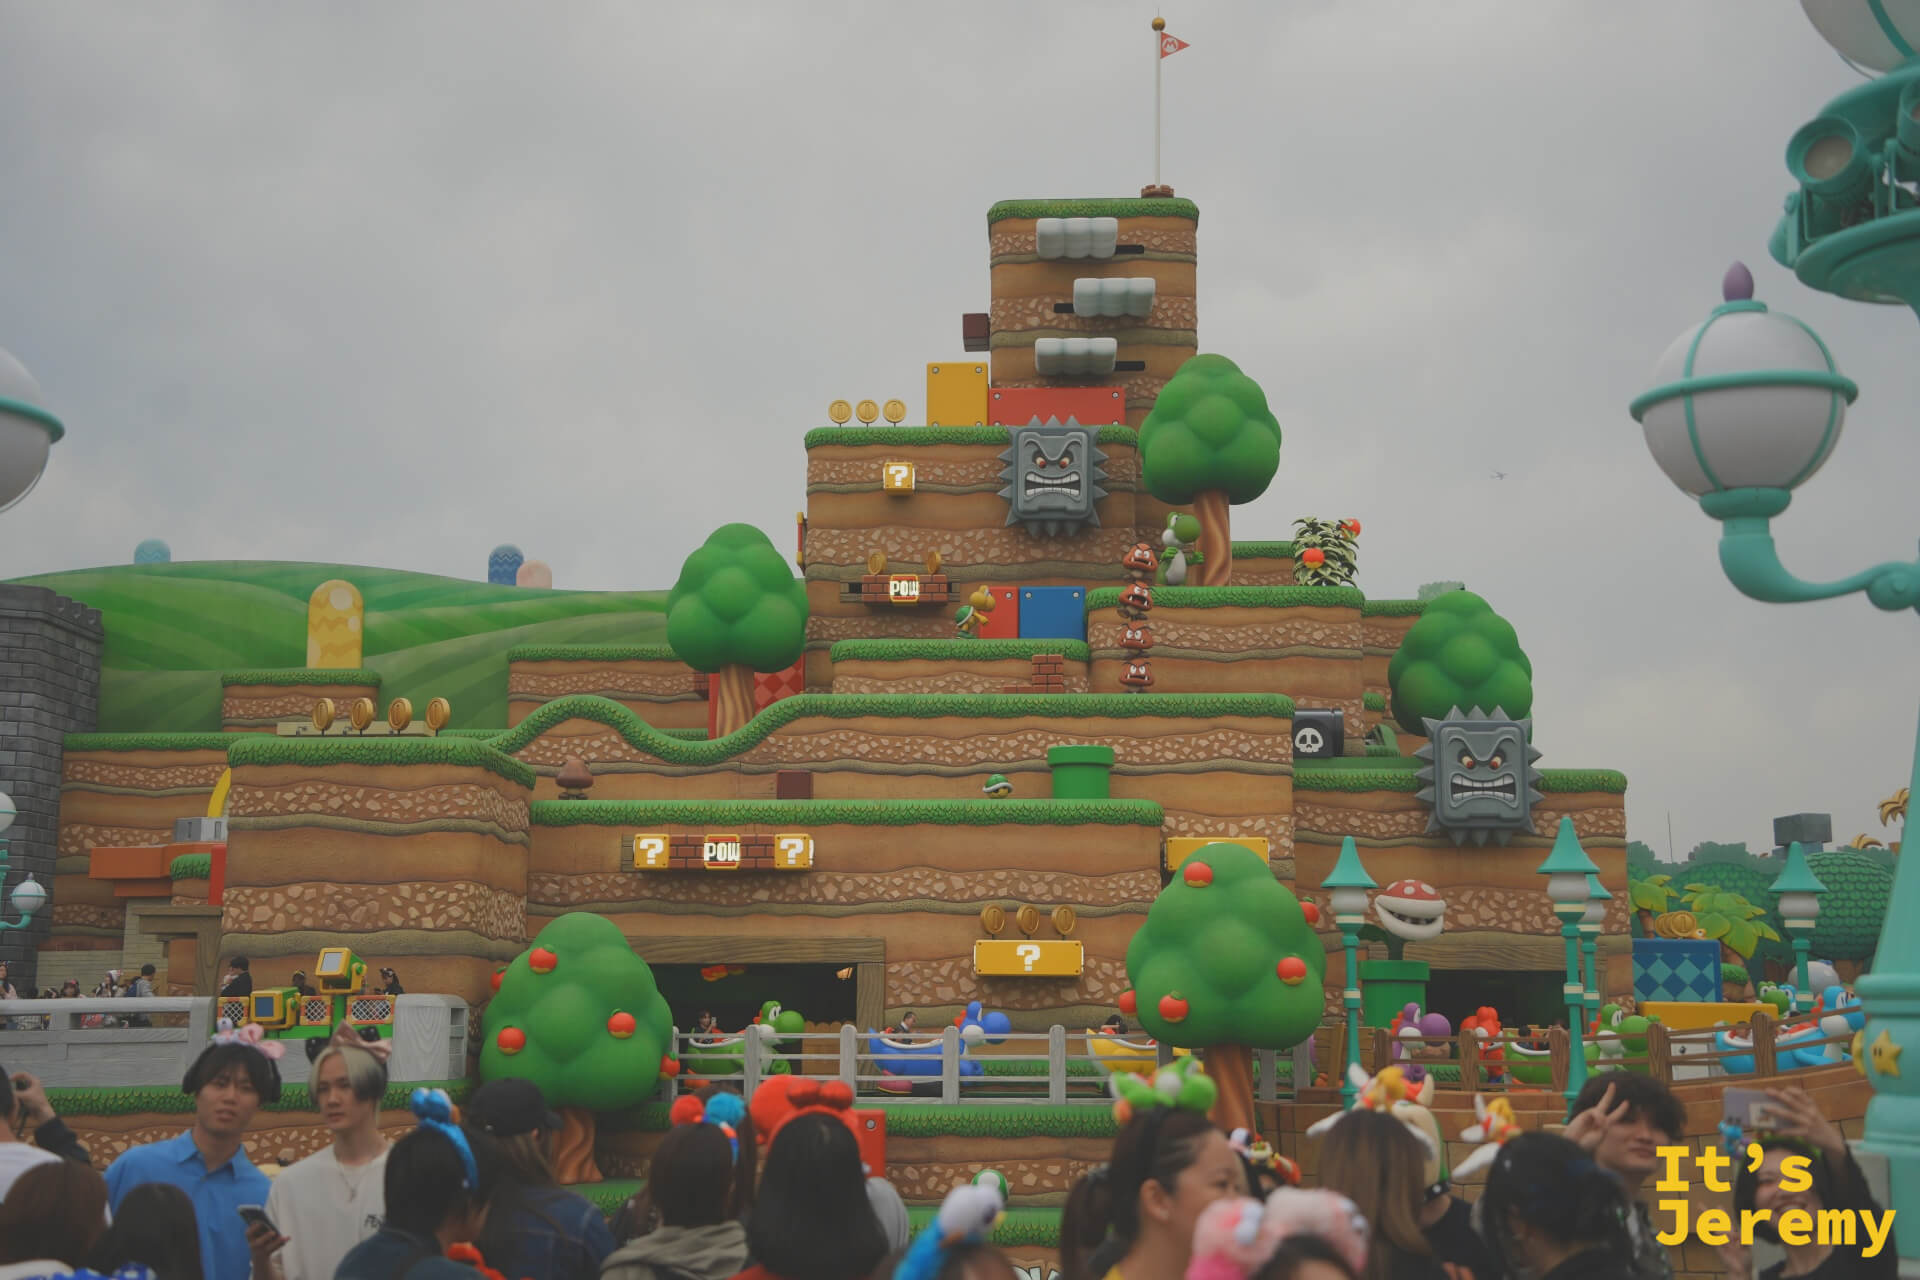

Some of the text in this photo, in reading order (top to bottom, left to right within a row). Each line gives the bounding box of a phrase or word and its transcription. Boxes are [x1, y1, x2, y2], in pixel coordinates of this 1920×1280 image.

[889, 465, 908, 487] ?
[889, 580, 920, 596] POW
[639, 838, 664, 865] ?
[703, 842, 741, 862] POW
[1016, 944, 1041, 972] ?
